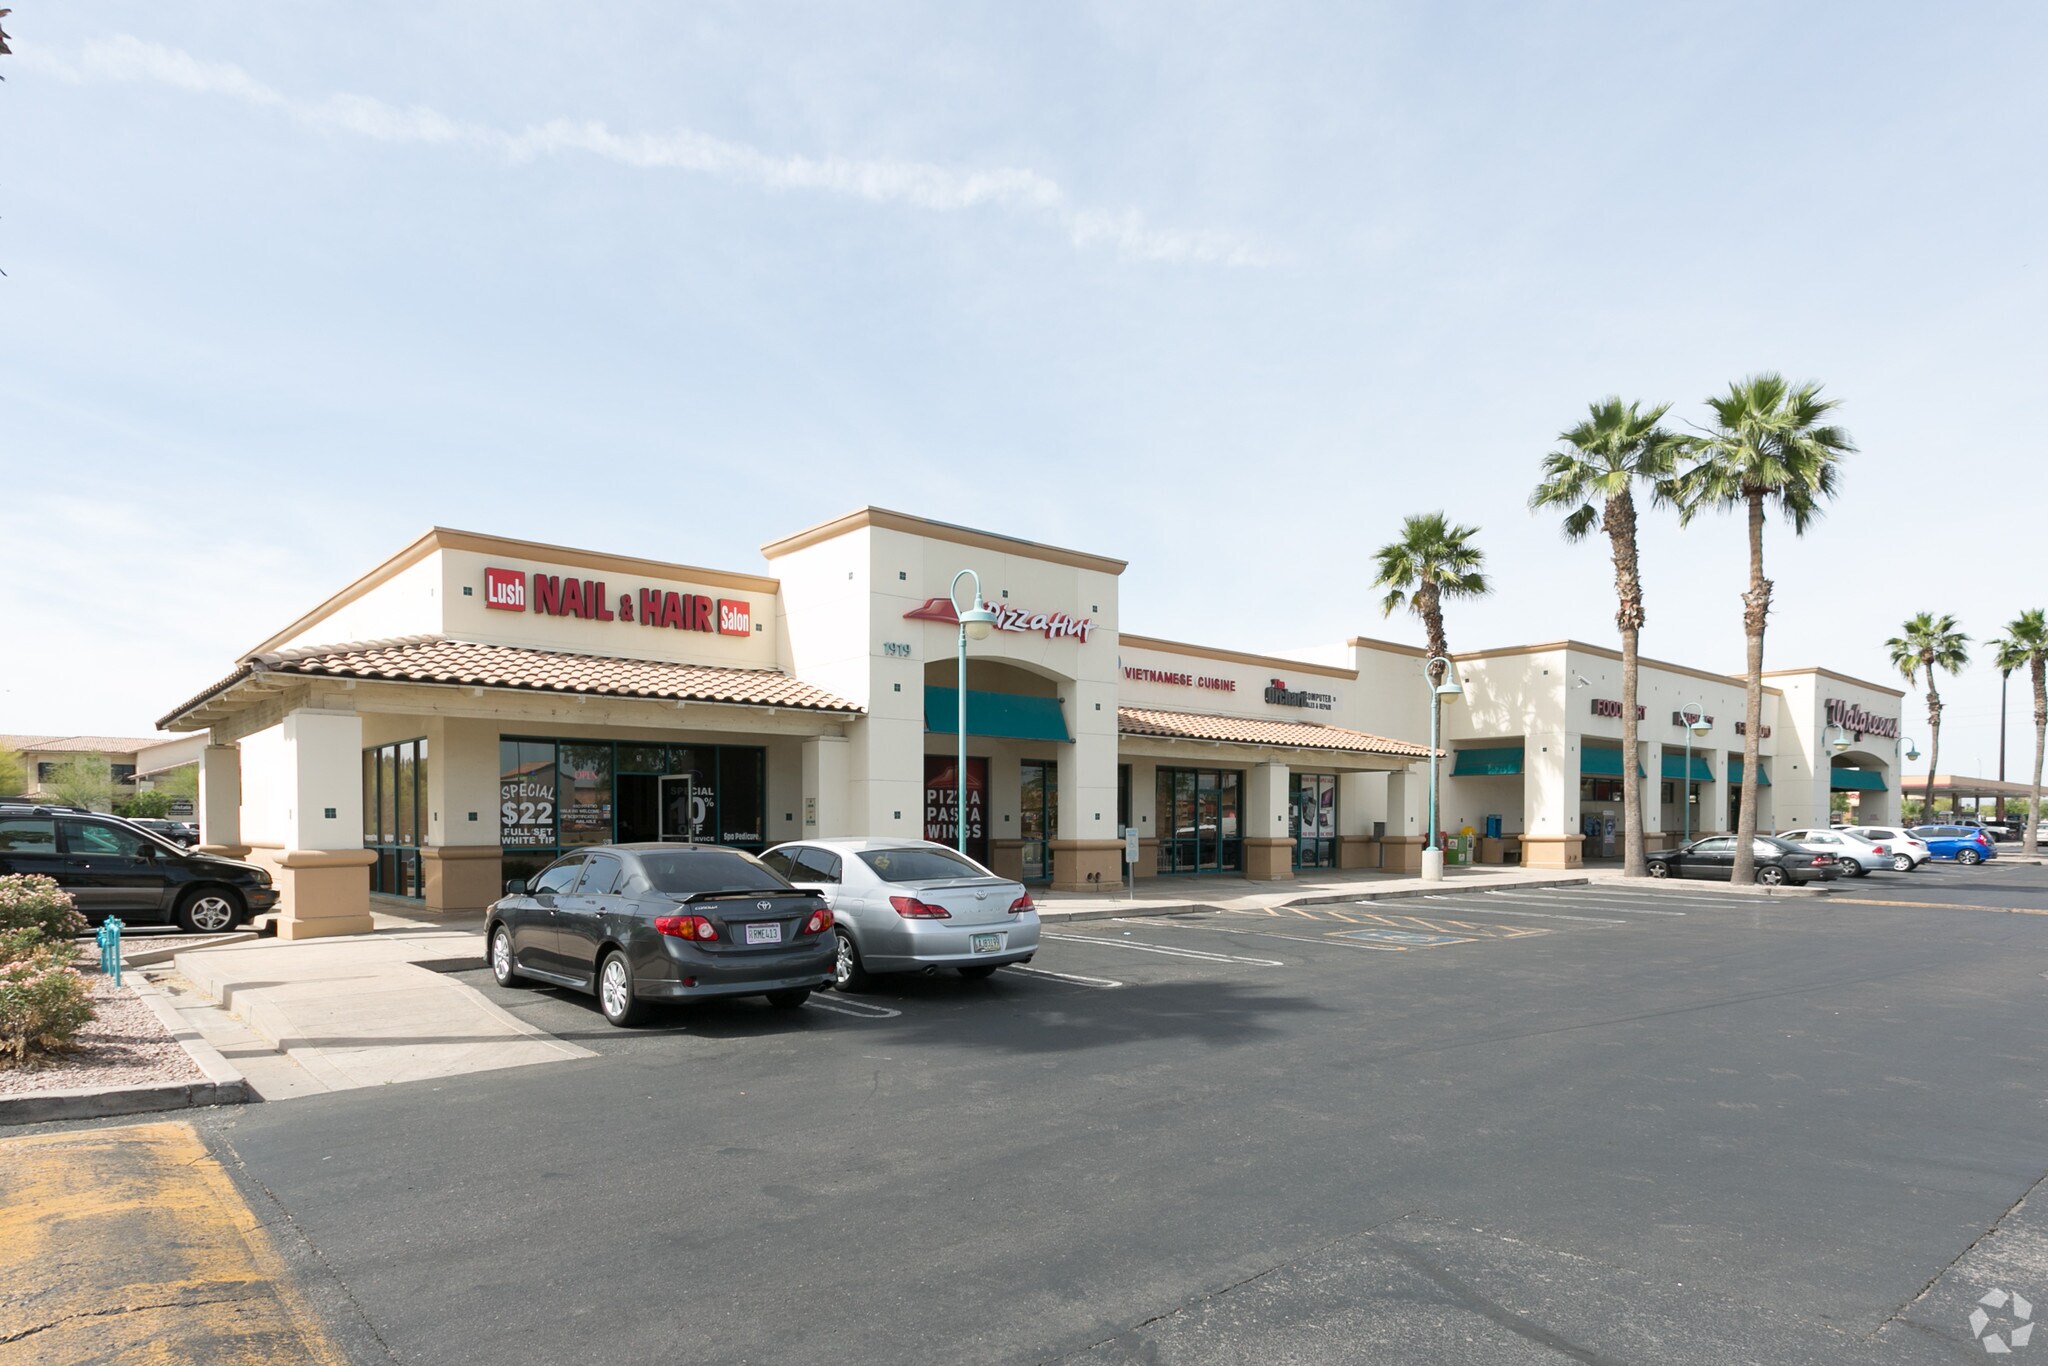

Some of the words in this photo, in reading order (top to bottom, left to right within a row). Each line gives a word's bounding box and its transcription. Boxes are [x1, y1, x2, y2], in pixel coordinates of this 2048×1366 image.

[488, 574, 525, 606] Lush
[534, 573, 614, 621] NAIL
[619, 593, 635, 622] &
[640, 587, 714, 633] HAIR
[721, 605, 749, 632] Salon
[1045, 611, 1099, 644] Hut
[883, 641, 911, 657] 1919
[1124, 666, 1193, 687] VIETNAMESE
[1196, 676, 1236, 692] CUISINE
[1597, 699, 1623, 718] FOOD
[1828, 699, 1899, 742] Walgreens
[501, 783, 554, 800] SPECIAL
[927, 789, 981, 805] PIZA
[501, 801, 553, 827] $22
[927, 807, 981, 822] PASA
[501, 836, 536, 845] WHITE
[540, 836, 556, 844] TIP
[504, 828, 530, 836] FULL
[533, 828, 553, 836] SET
[723, 832, 734, 842] Spa
[735, 832, 759, 841] Pedicure
